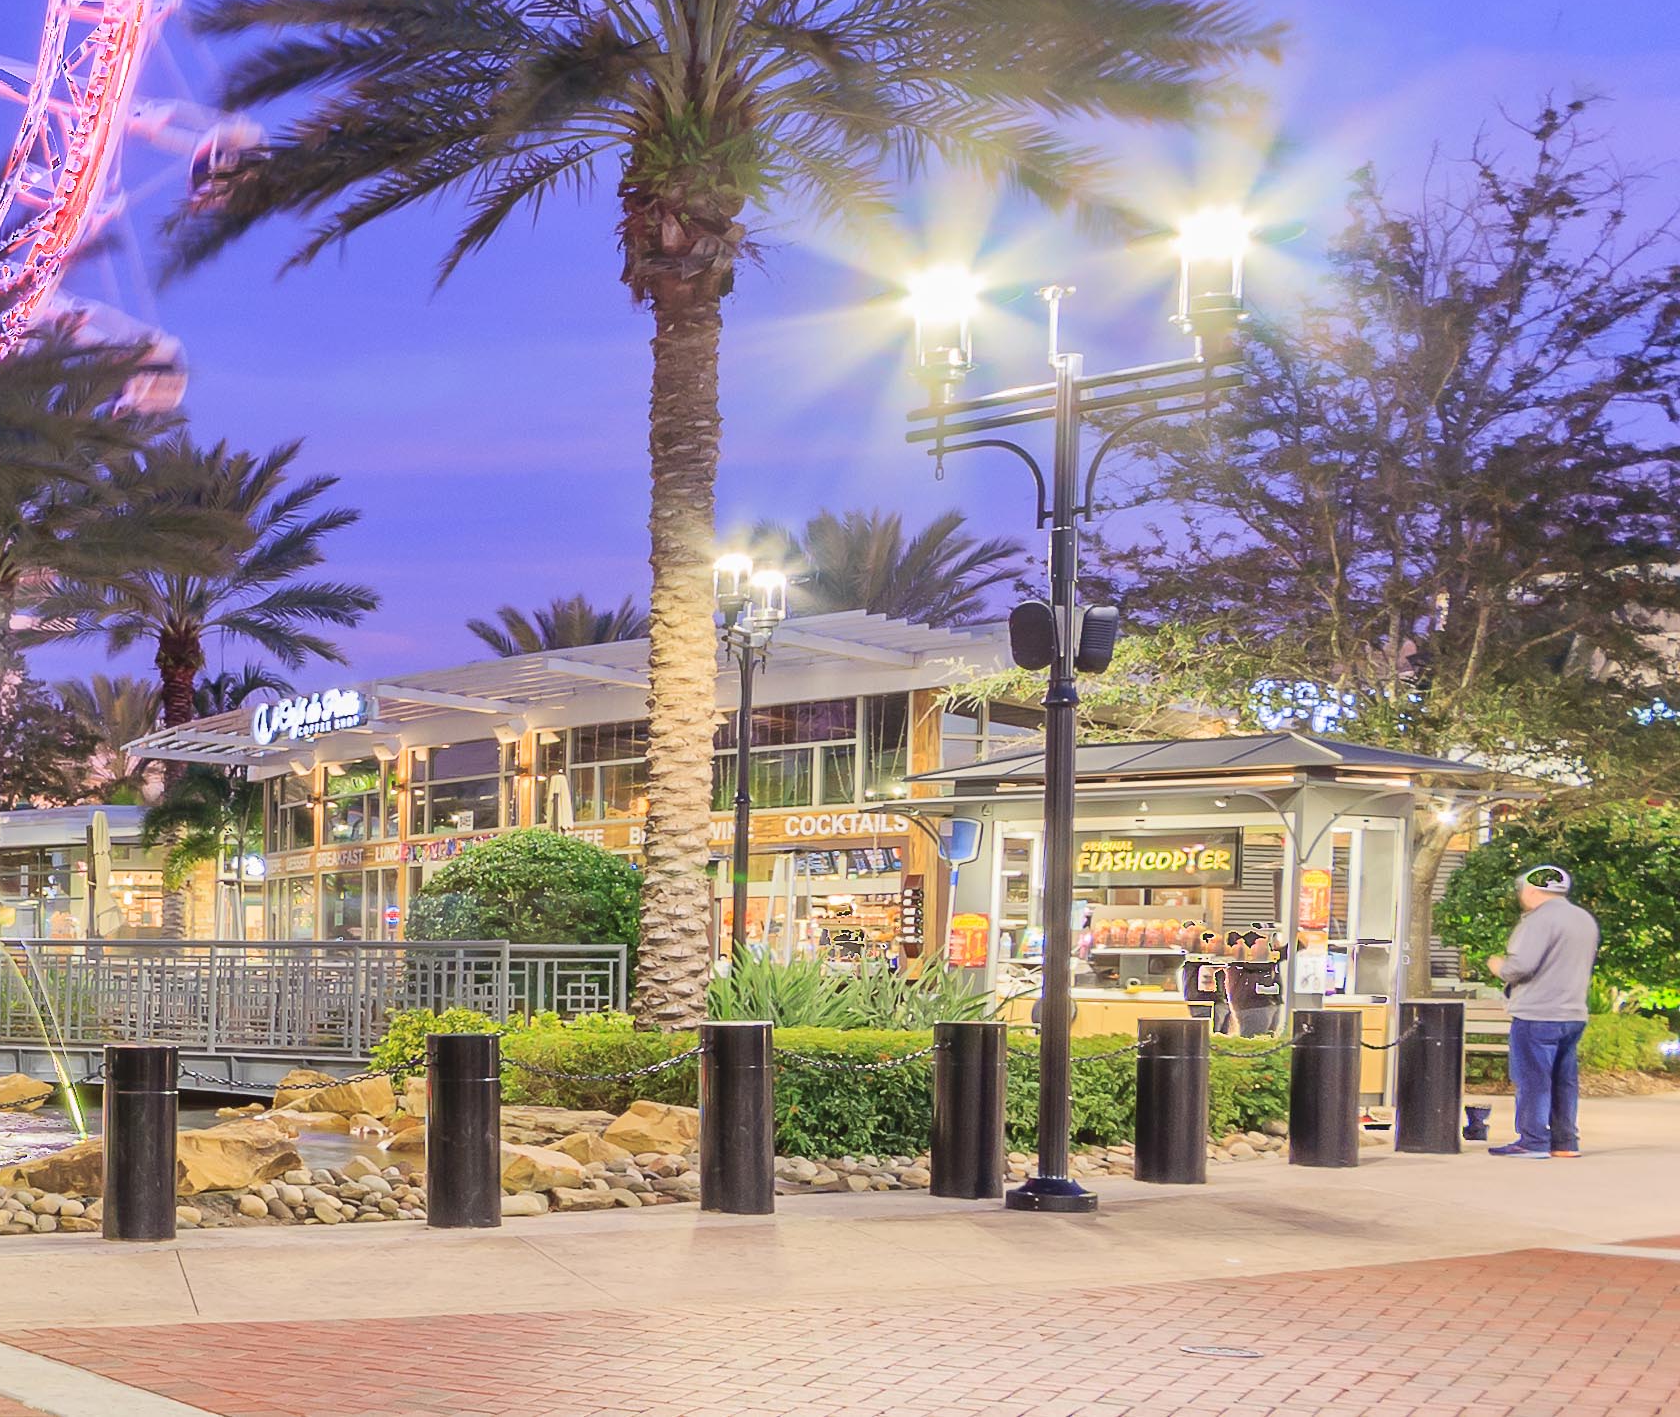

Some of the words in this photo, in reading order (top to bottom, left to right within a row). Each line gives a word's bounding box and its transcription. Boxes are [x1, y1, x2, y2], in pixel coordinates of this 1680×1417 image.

[334, 714, 360, 730] SHOP
[785, 814, 909, 837] COCKTAILS
[1081, 841, 1133, 852] ORIGINAL
[317, 849, 364, 867] BREAKFAST
[1077, 845, 1230, 873] FLASHCOPTER
